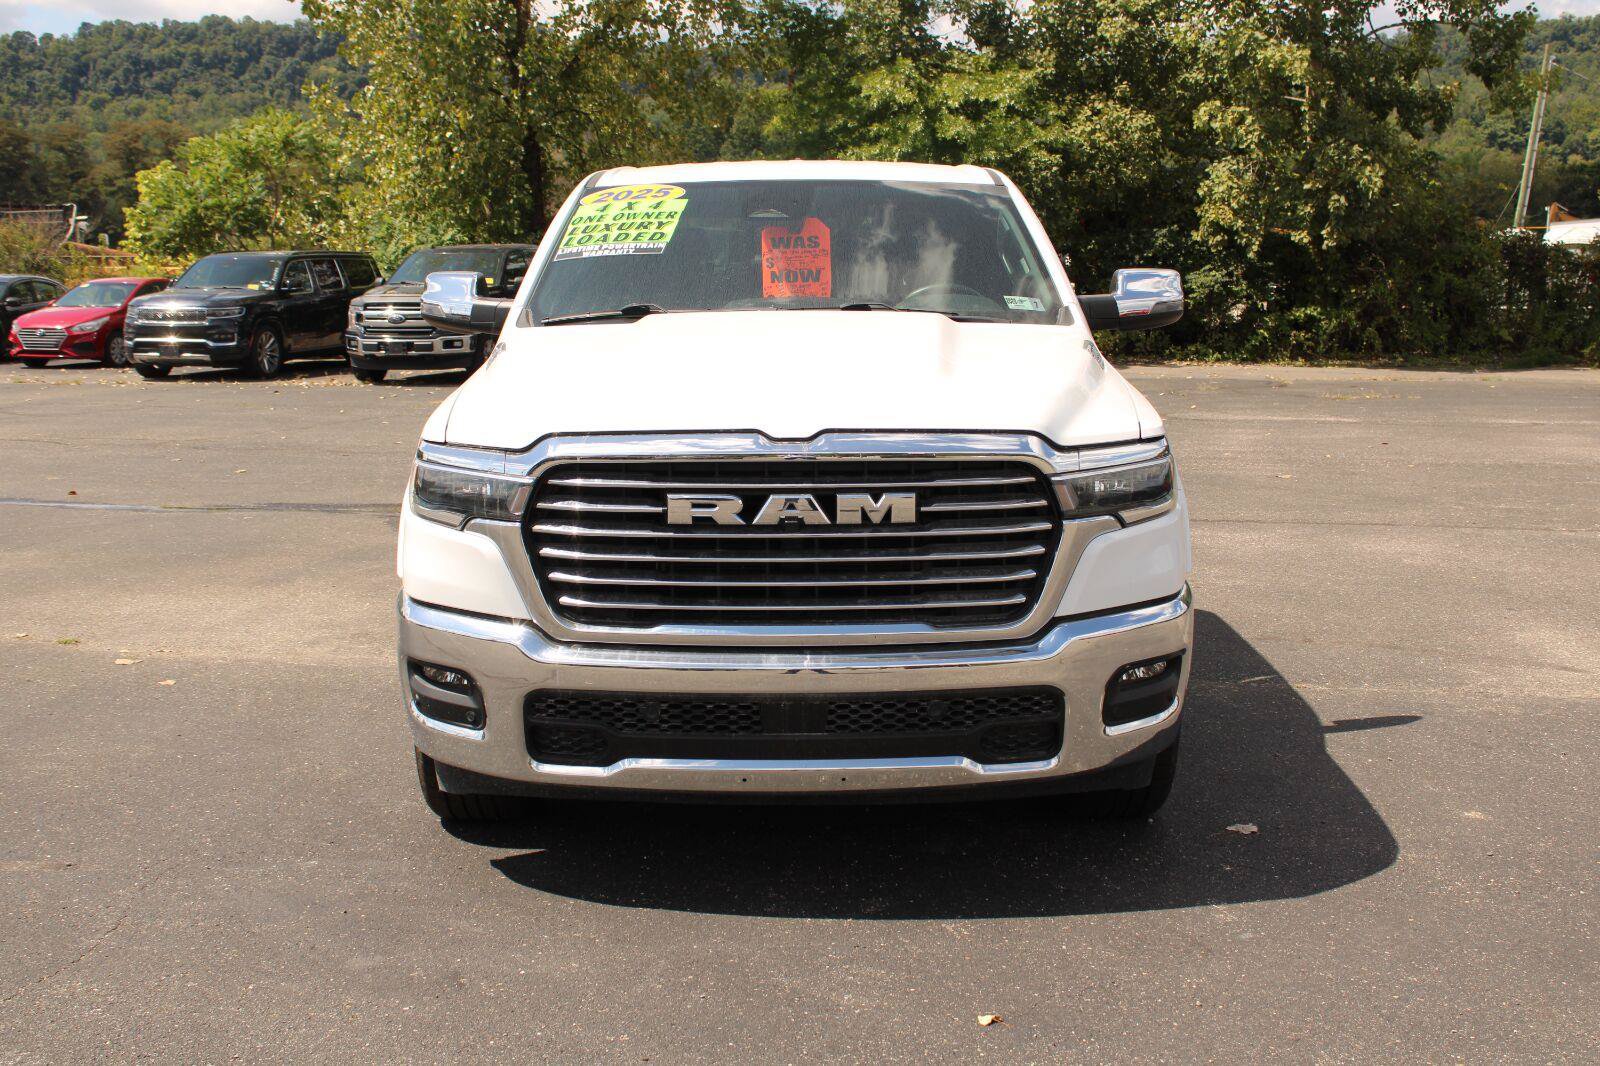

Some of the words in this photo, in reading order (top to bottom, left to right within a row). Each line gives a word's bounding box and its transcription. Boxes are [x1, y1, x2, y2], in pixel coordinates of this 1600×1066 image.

[593, 188, 672, 203] 2025
[596, 202, 612, 212] 4
[649, 200, 664, 210] 4
[571, 214, 606, 226] ONE
[612, 211, 678, 222] OWNER
[567, 221, 672, 236] LUXURY
[563, 232, 666, 247] LOADED
[770, 236, 821, 249] WAS
[559, 244, 600, 255] LIFETIME
[602, 242, 665, 250] POWERTRAIN
[582, 248, 635, 257] WARRANTY
[770, 269, 821, 283] NOW
[666, 493, 916, 525] RAM
